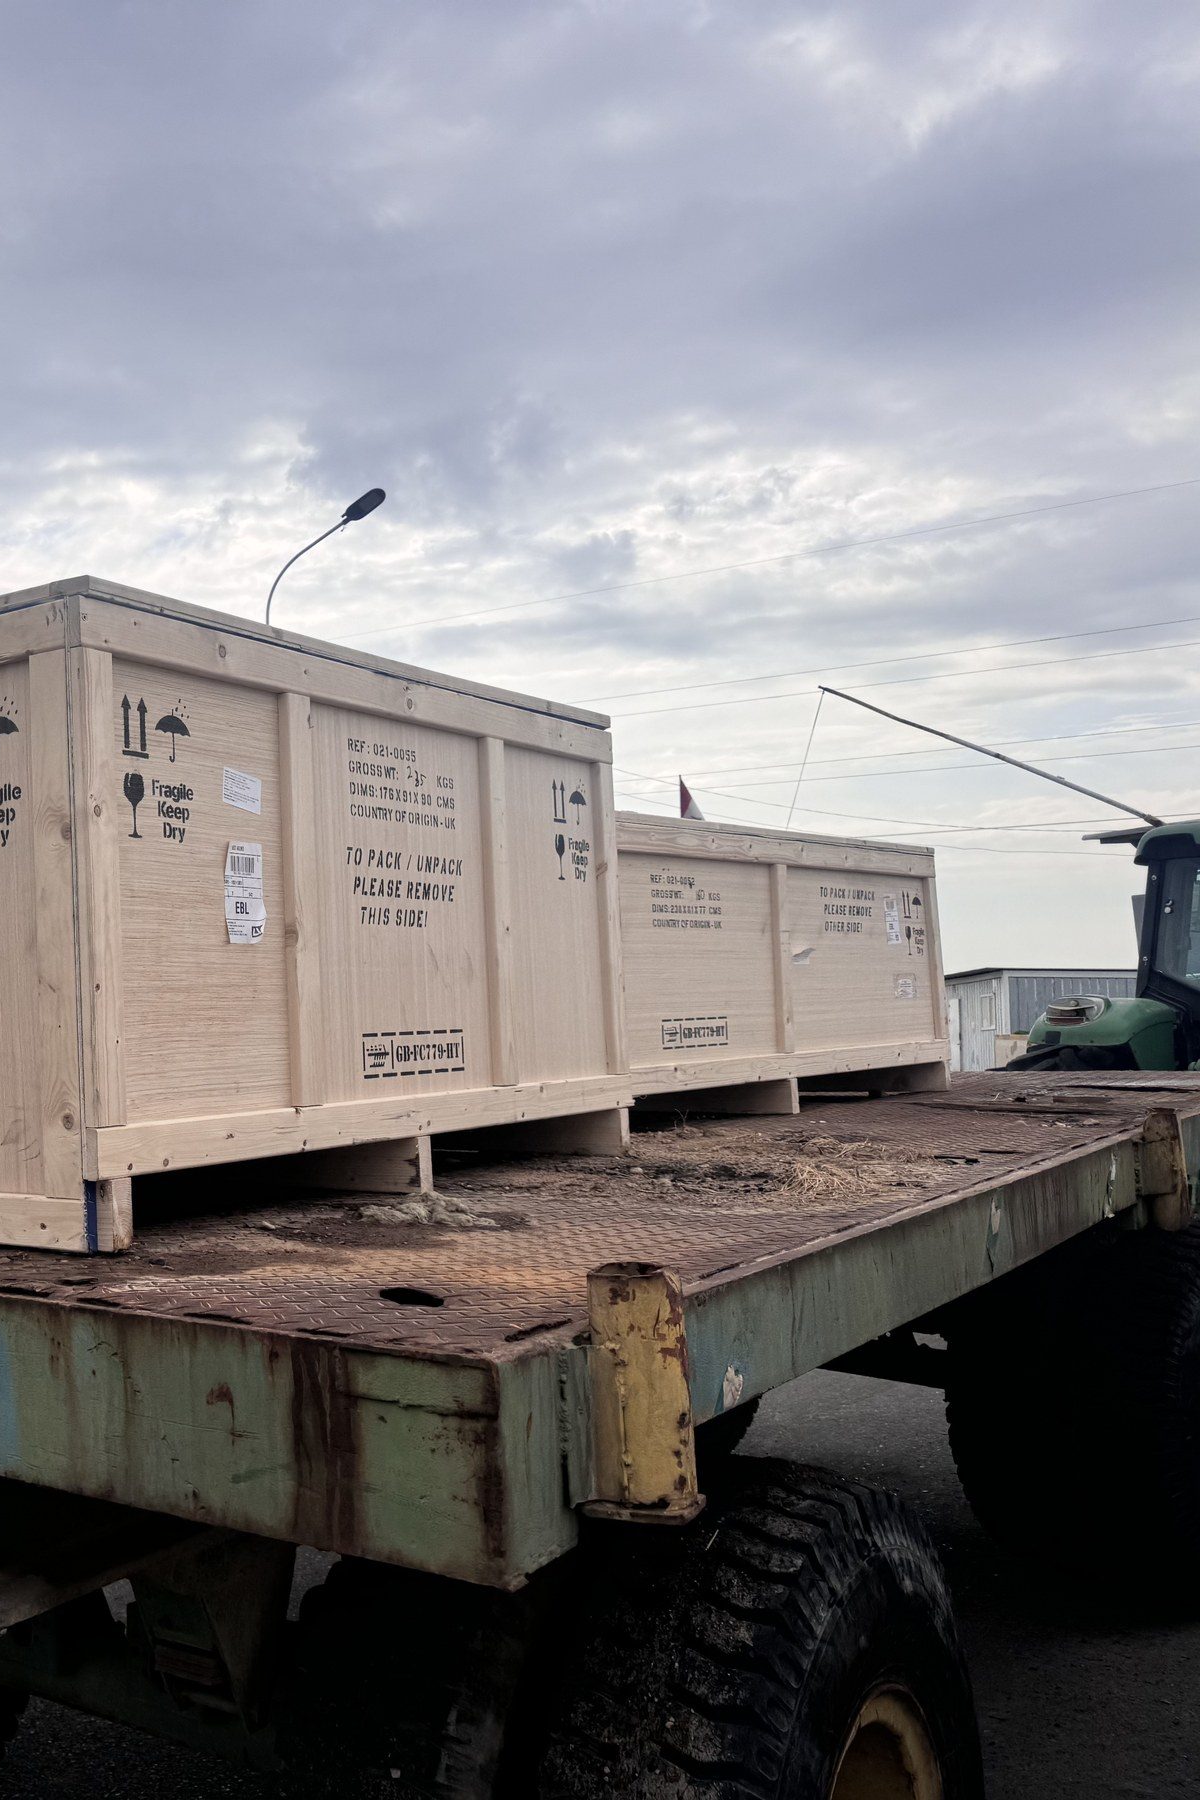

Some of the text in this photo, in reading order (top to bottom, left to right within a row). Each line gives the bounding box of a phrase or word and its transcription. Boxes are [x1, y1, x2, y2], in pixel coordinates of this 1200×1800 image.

[347, 738, 416, 762] REF: 021-0055
[436, 775, 454, 789] KGS
[151, 778, 194, 803] Fragile
[436, 796, 455, 810] CMS
[157, 800, 190, 823] Keep
[350, 803, 393, 822] COUNTRY
[395, 810, 407, 823] OF
[408, 812, 439, 828] ORIGIN
[444, 817, 456, 830] UK
[162, 822, 186, 843] Dry
[568, 837, 590, 854] Fragile
[346, 846, 363, 866] TO
[367, 849, 402, 870] PACK
[416, 854, 463, 877] UNPACK
[571, 852, 589, 868] Keep
[574, 867, 587, 882] Dry
[353, 876, 455, 902] PLEASE REMOVE
[708, 892, 721, 901] KGS
[820, 886, 828, 898] TO
[829, 887, 846, 899] PACK
[852, 889, 875, 901] UNPACK
[235, 901, 250, 915] EBL
[708, 906, 722, 915] CMS
[823, 904, 847, 916] PLEASE
[848, 905, 872, 918] REMOVE
[361, 906, 428, 928] THIS SIDE!
[652, 918, 680, 928] COUNTRY
[680, 919, 689, 928] OF
[689, 920, 711, 929] ORIGIN
[824, 920, 863, 933] OTHER SIDE!
[395, 1042, 461, 1063] GB-FC779-HT
